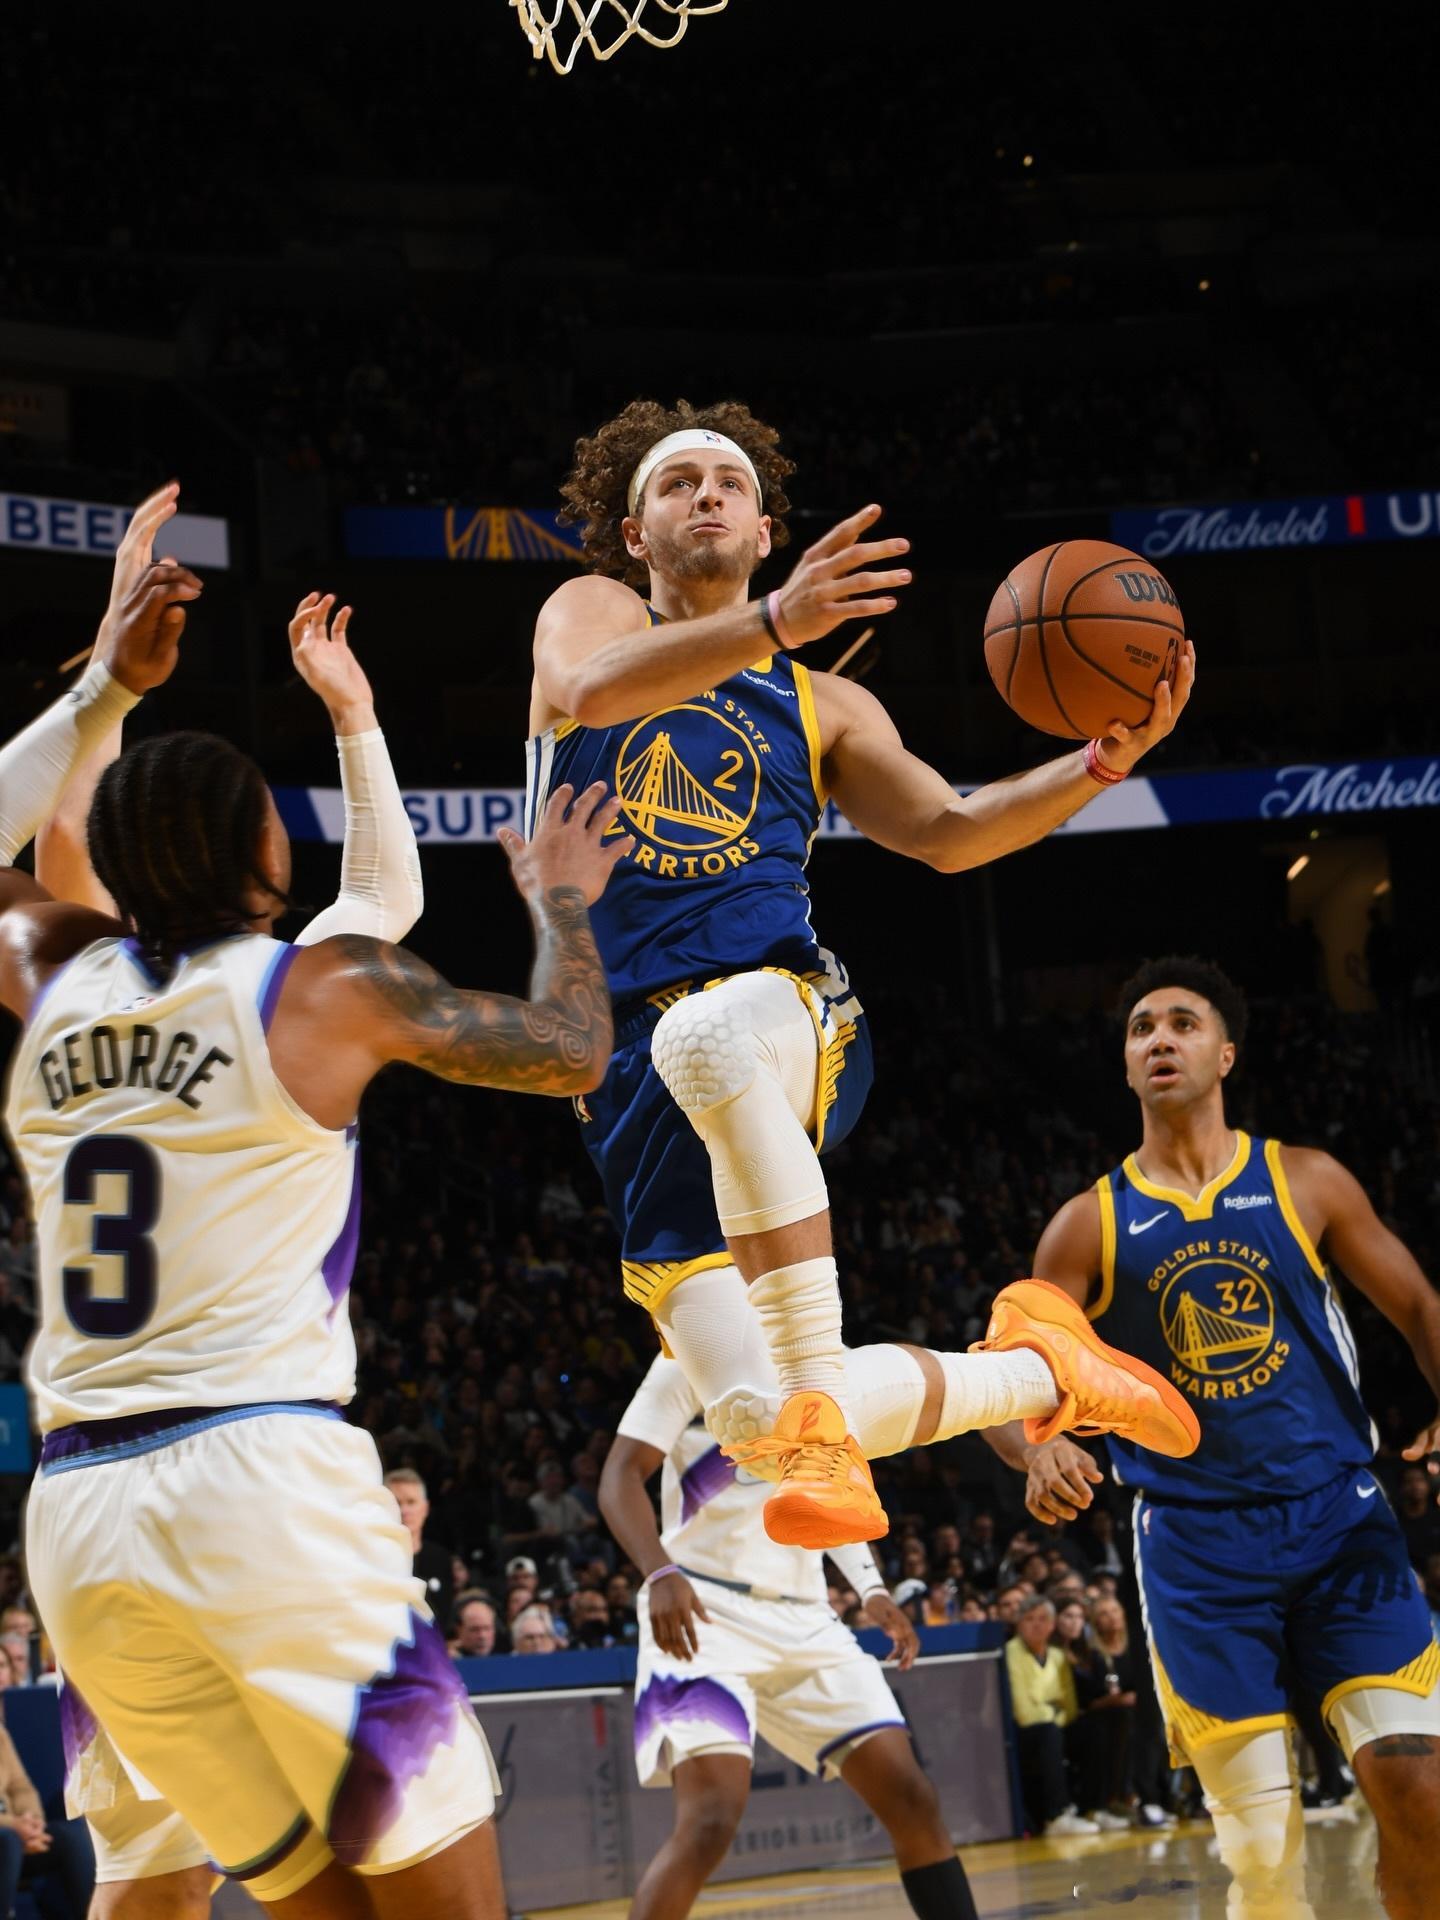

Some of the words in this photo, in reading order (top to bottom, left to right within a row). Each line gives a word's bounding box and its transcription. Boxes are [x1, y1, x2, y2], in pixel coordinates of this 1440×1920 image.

[8, 498, 132, 551] BEE
[1143, 503, 1328, 558] Michelob
[1386, 492, 1440, 538] U
[724, 699, 772, 754] STATE
[713, 749, 744, 792] 2
[403, 794, 526, 837] SUP
[41, 1024, 234, 1110] GEORGE
[1223, 1194, 1272, 1210] Rakuten
[62, 1133, 163, 1339] 3
[1147, 1240, 1210, 1292] GOLDEN
[1217, 1240, 1270, 1272] STATE
[1215, 1278, 1260, 1315] 32
[1170, 1339, 1290, 1399] WARRIORS
